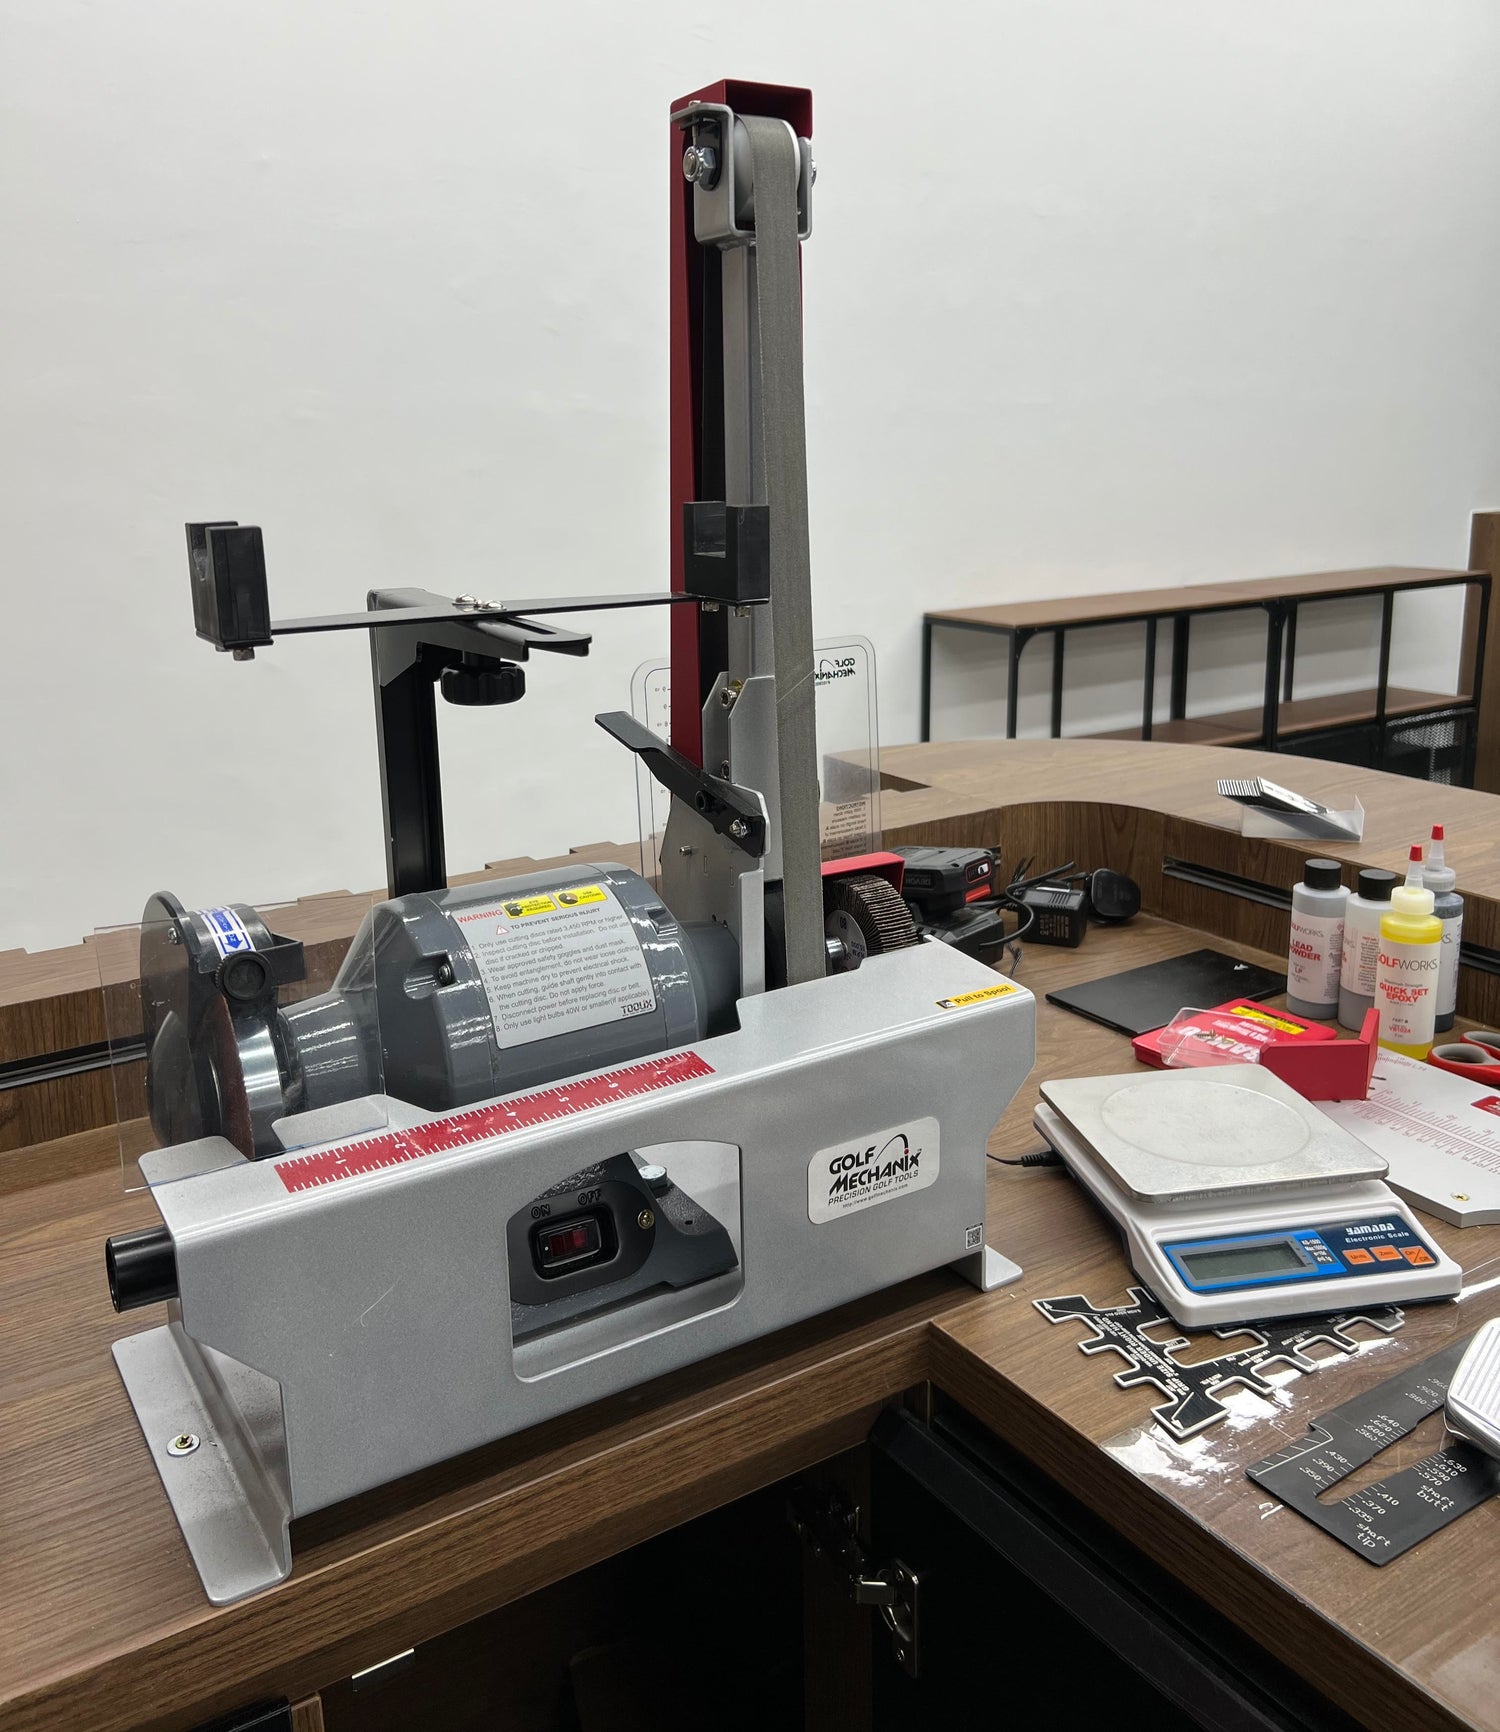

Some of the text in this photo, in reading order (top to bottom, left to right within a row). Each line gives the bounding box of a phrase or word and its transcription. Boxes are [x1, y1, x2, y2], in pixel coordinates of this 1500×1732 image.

[458, 909, 502, 924] WARNING
[521, 918, 550, 928] PREVENT
[551, 912, 578, 921] SERIOUS
[580, 908, 600, 916] INJURY
[479, 942, 493, 950] Only
[508, 934, 529, 944] cutting
[530, 929, 545, 938] discs
[581, 920, 596, 928] RPM
[604, 915, 623, 923] higher
[482, 948, 505, 958] Inspect
[506, 942, 527, 952] cutting
[529, 939, 541, 947] disc
[542, 935, 561, 943] before
[1293, 939, 1312, 952] LEAD
[486, 957, 499, 965] disc
[505, 950, 530, 960] cracked
[488, 966, 506, 974] Wear
[507, 958, 536, 970] approved
[538, 955, 556, 963] safety
[557, 949, 580, 960] goggles
[494, 983, 511, 991] Keep
[513, 977, 539, 987] machine
[540, 974, 551, 983] dry
[559, 968, 582, 978] prevent
[583, 960, 609, 971] electrical
[501, 972, 518, 980] avoid
[497, 992, 516, 1001] When
[542, 982, 558, 992] guide
[560, 978, 575, 986] shaft
[576, 974, 594, 983] gently
[608, 966, 629, 975] contact
[1380, 982, 1429, 996] QUICK SET
[499, 1003, 509, 1011] the
[511, 998, 532, 1008] cutting
[571, 985, 587, 994] apply
[954, 996, 973, 1004] Pull
[984, 986, 1011, 995] Spool
[1386, 991, 1418, 1004] EPOXY
[502, 1007, 537, 1020] Disconnect
[538, 1003, 557, 1013] power
[559, 997, 578, 1006] before
[579, 990, 607, 1001] replacing
[503, 1022, 518, 1030] Only
[533, 1015, 546, 1024] light
[548, 1011, 564, 1019] bulbs
[566, 1006, 580, 1014] 40W
[829, 1146, 876, 1174] GOLF
[829, 1150, 921, 1196] MECHANIX
[828, 1170, 919, 1206] PRECISION GOLF TOOLS
[578, 1189, 601, 1205] OFF
[531, 1204, 551, 1219] ON
[1345, 1231, 1410, 1244] Electronic Scale
[1370, 1418, 1392, 1432] .620
[1377, 1414, 1400, 1427] .640
[1363, 1424, 1385, 1437] .600
[1325, 1450, 1347, 1464] .430
[1312, 1458, 1334, 1472] .390
[1435, 1464, 1458, 1476] .610
[1444, 1459, 1467, 1473] .630
[1299, 1467, 1321, 1481] .350
[1419, 1472, 1443, 1486] .570
[1427, 1468, 1450, 1482] .590
[1377, 1492, 1400, 1506] .410
[1416, 1490, 1449, 1512] butt
[1421, 1484, 1455, 1507] shaft
[1348, 1507, 1374, 1522] .335
[1362, 1500, 1386, 1514] .370
[1356, 1523, 1391, 1546] shaft
[1357, 1532, 1376, 1548] tip
